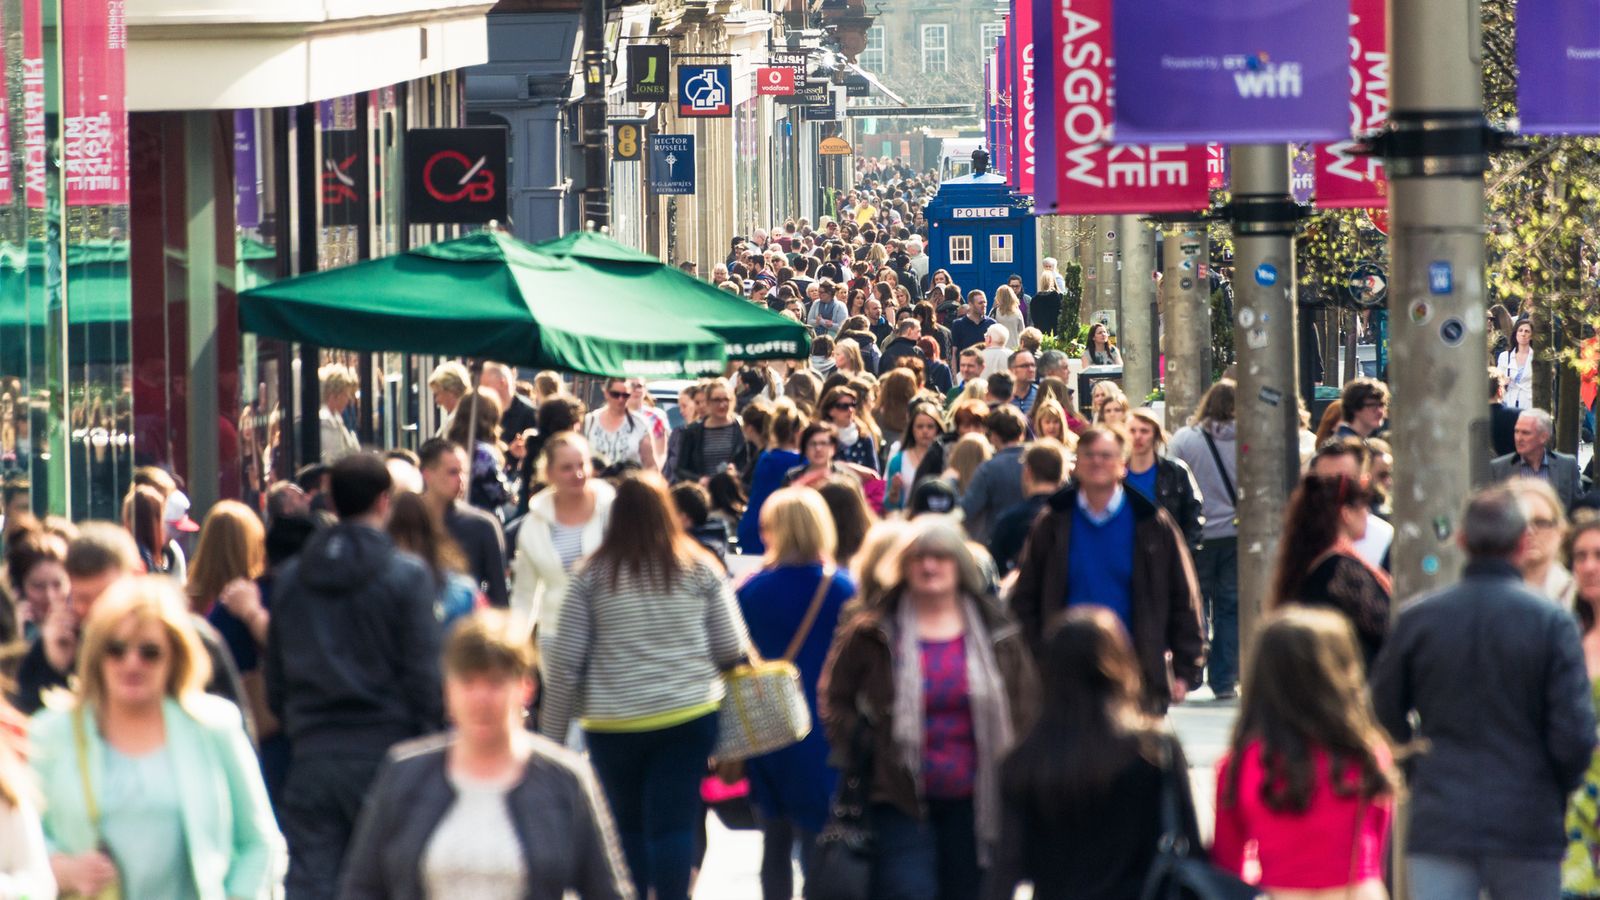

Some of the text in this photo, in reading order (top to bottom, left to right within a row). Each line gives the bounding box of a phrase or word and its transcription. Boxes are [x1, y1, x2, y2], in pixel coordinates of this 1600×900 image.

[771, 55, 805, 65] LUSH
[1234, 62, 1304, 98] wifi
[632, 84, 665, 95] JONES
[804, 86, 823, 94] ussell
[1062, 0, 1105, 188] ASGOW
[654, 137, 688, 145] HECTOR
[654, 144, 688, 152] RUSSELL
[956, 208, 1005, 218] POLICE
[746, 341, 798, 355] COFFEE
